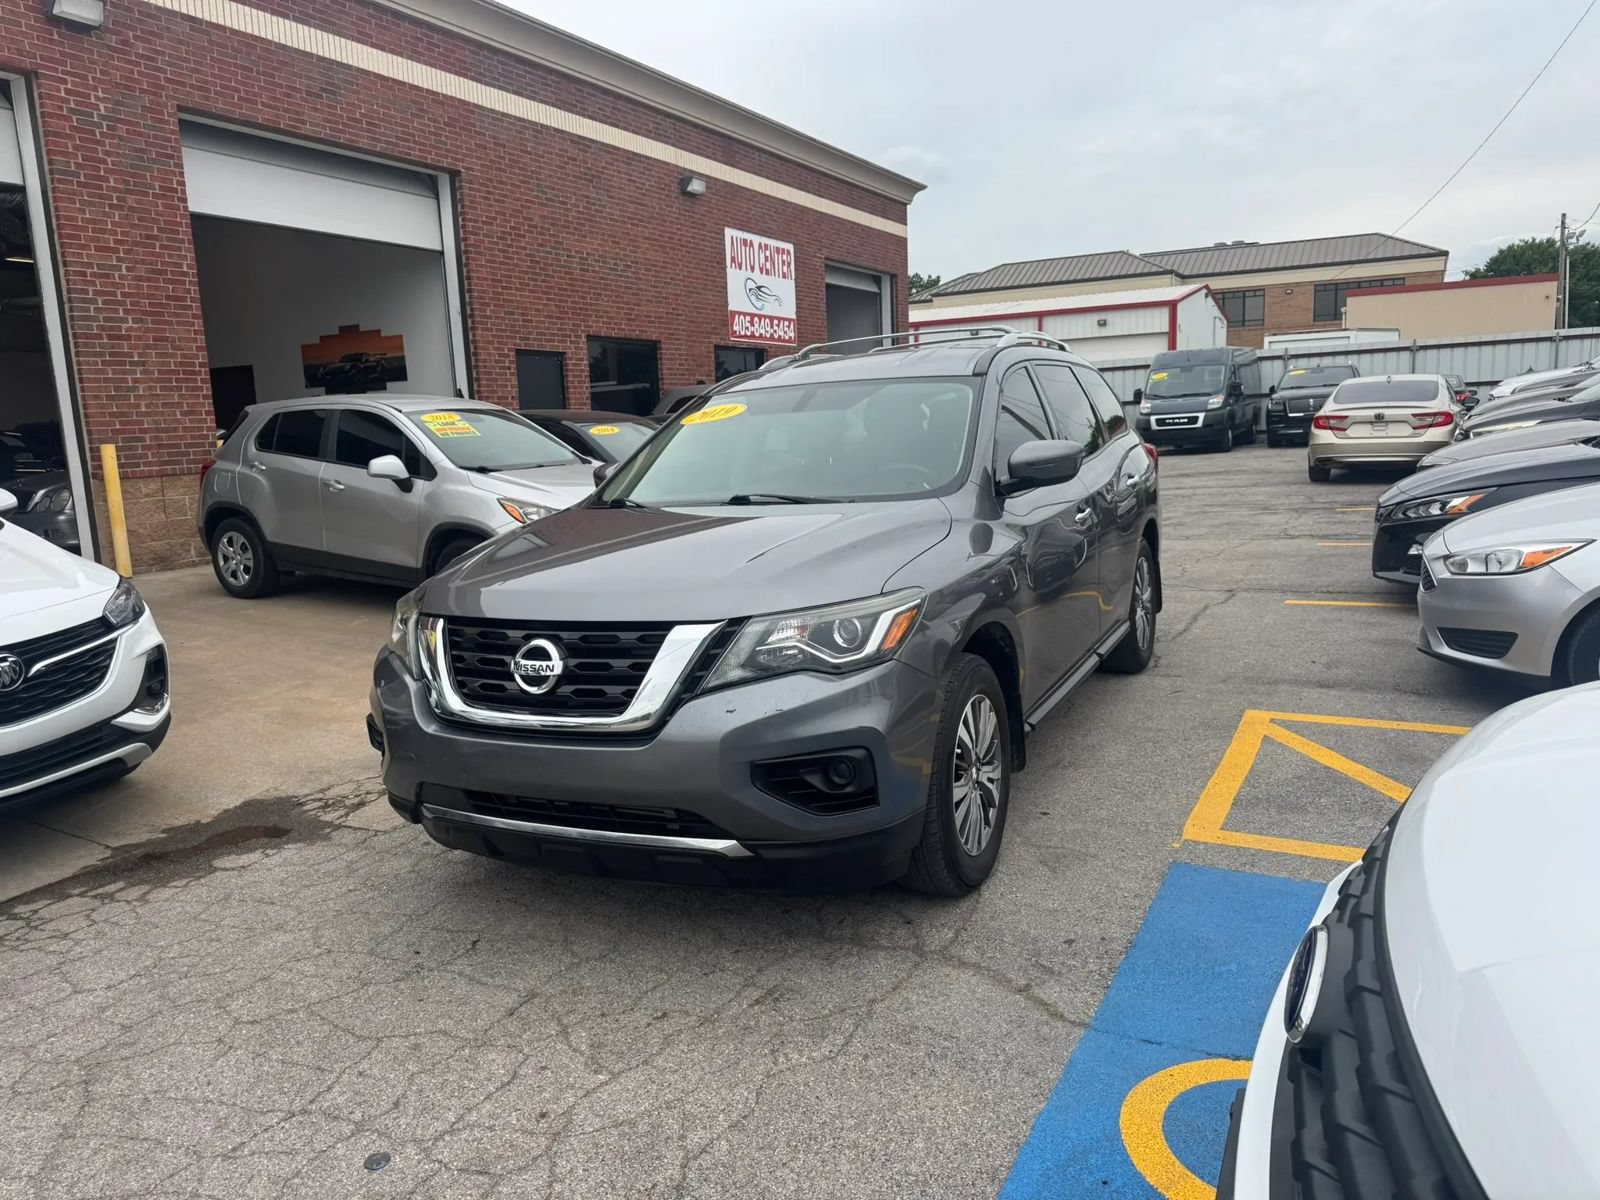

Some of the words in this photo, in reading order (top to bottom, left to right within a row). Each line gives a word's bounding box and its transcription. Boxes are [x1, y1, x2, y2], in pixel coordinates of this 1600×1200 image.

[731, 235, 756, 273] AUTO
[758, 242, 792, 280] CENTER
[733, 314, 795, 340] 405-849-5454
[514, 661, 555, 673] NISSAN
